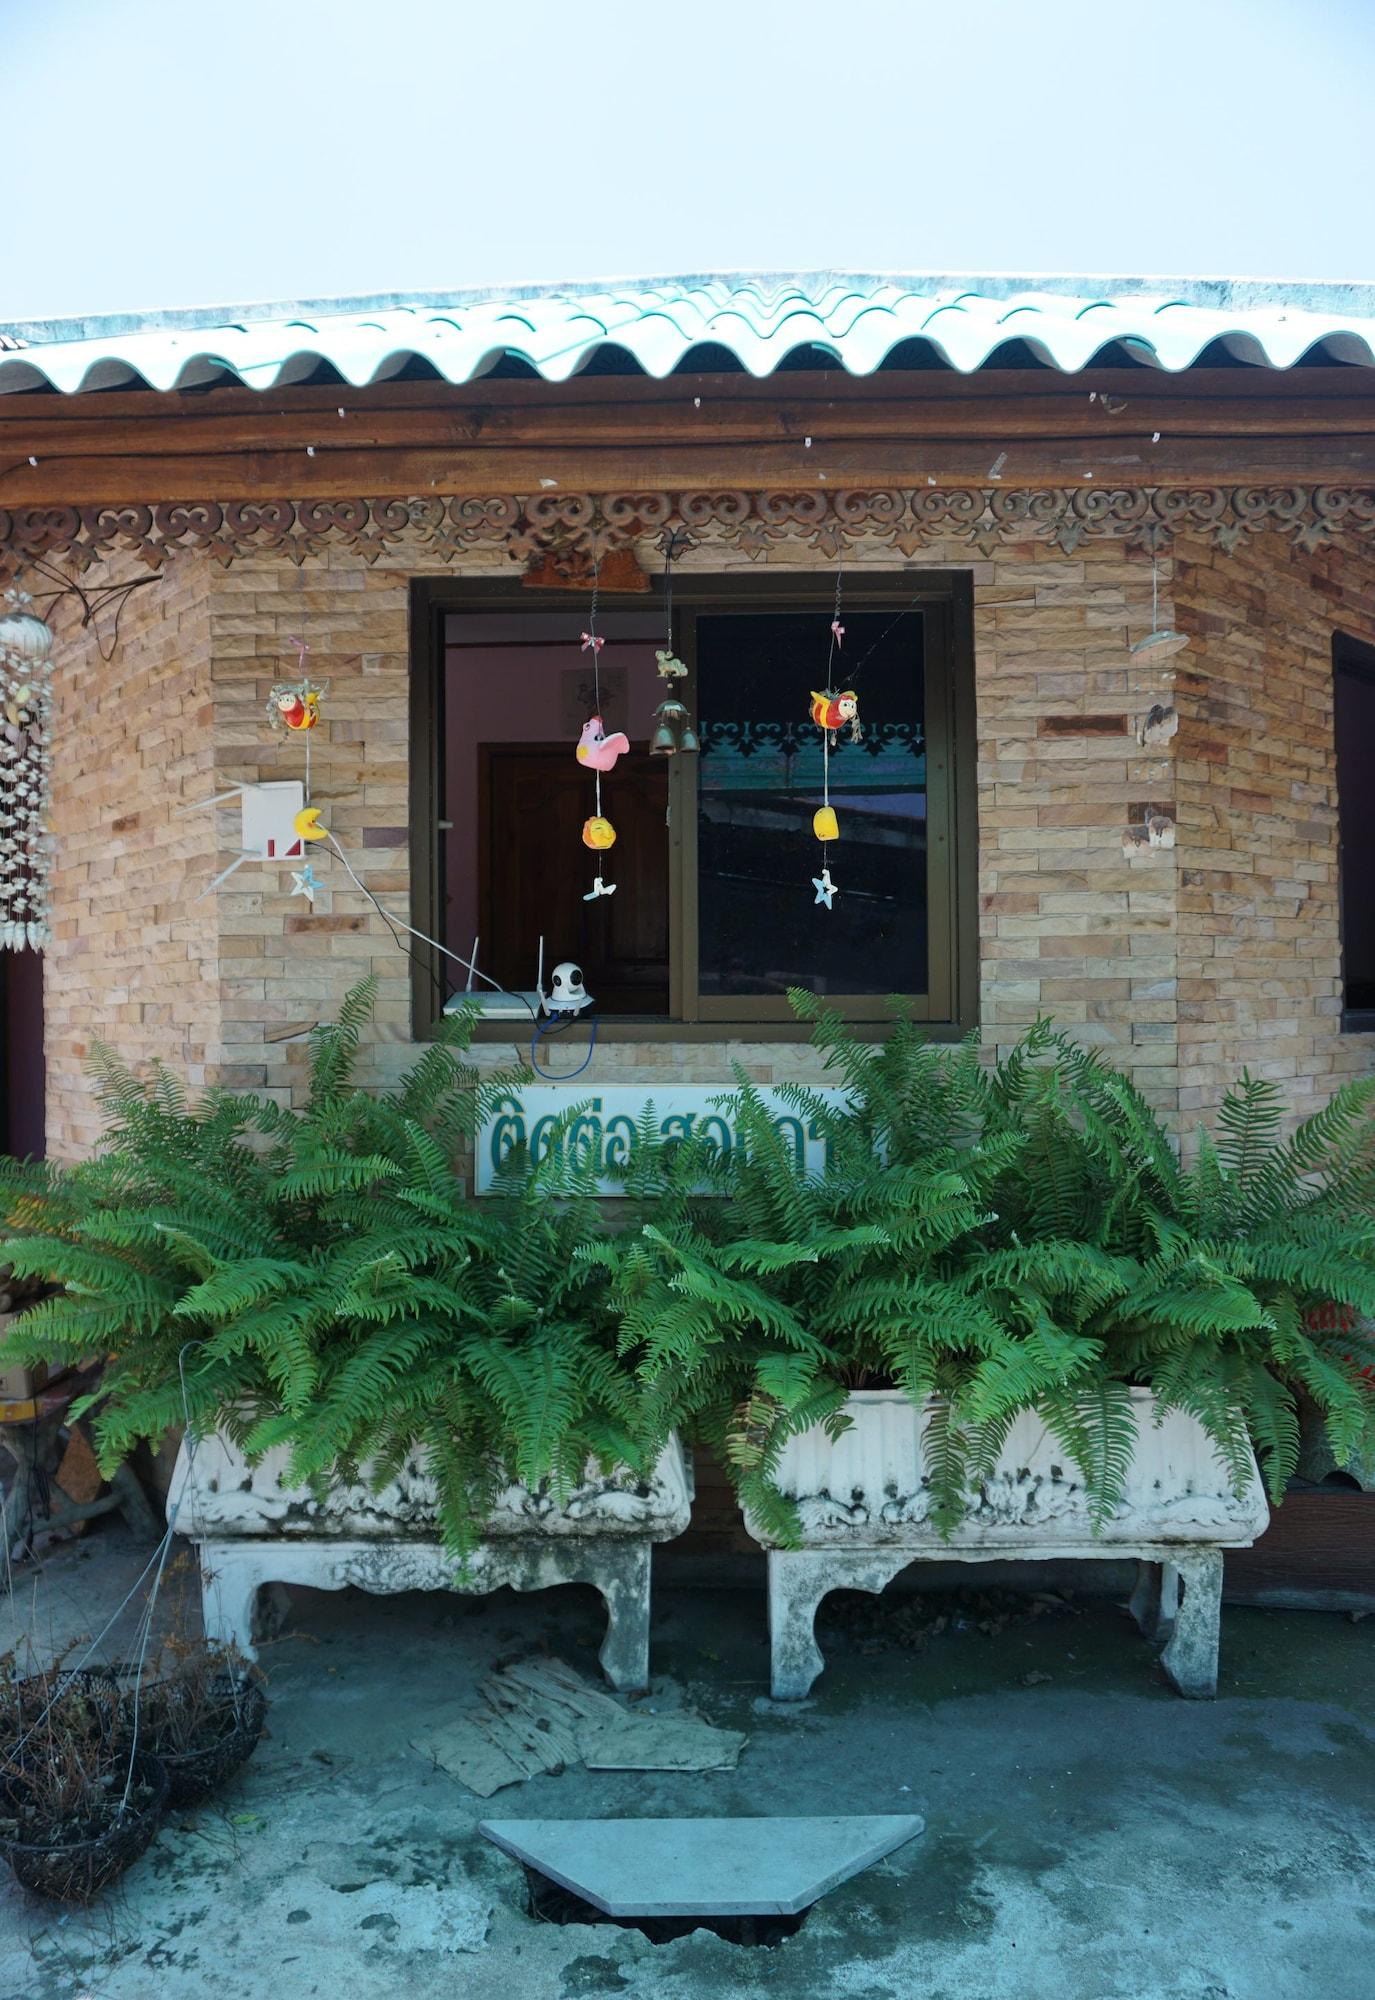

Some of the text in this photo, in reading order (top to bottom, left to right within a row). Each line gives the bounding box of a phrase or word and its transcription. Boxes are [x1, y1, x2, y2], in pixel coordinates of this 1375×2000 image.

[490, 1094, 873, 1178] ติดต่อ สอถา
